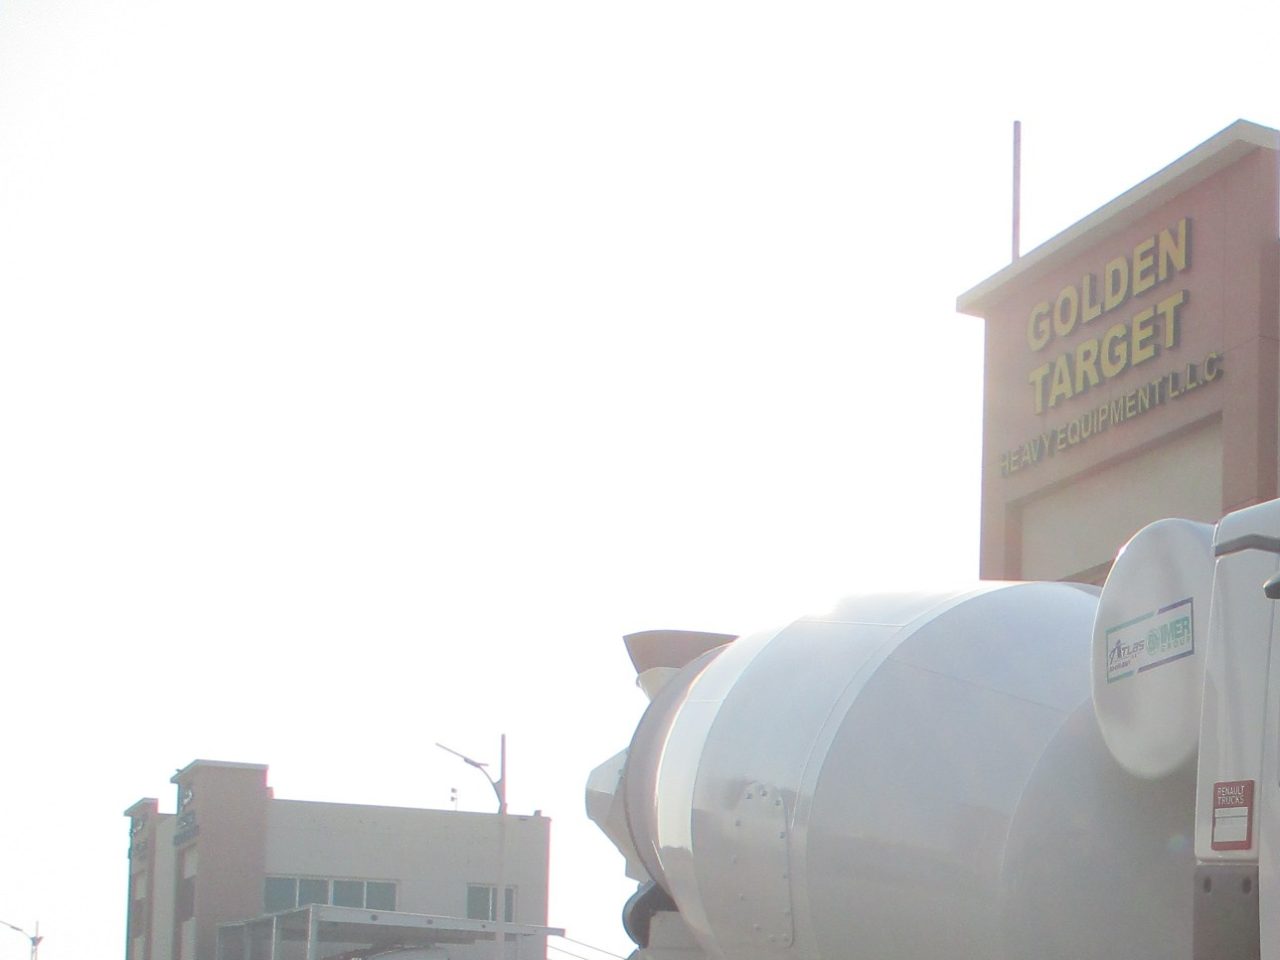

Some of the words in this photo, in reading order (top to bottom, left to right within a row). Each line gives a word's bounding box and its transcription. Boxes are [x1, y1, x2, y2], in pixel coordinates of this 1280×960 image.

[1026, 217, 1190, 352] GOLDEN
[1029, 289, 1185, 416] TARGET
[1000, 432, 1050, 475] HEAVY
[1056, 380, 1162, 451] EQUIPMENT
[1217, 785, 1245, 797] RENAULT
[1217, 794, 1245, 806] TRUCKS
